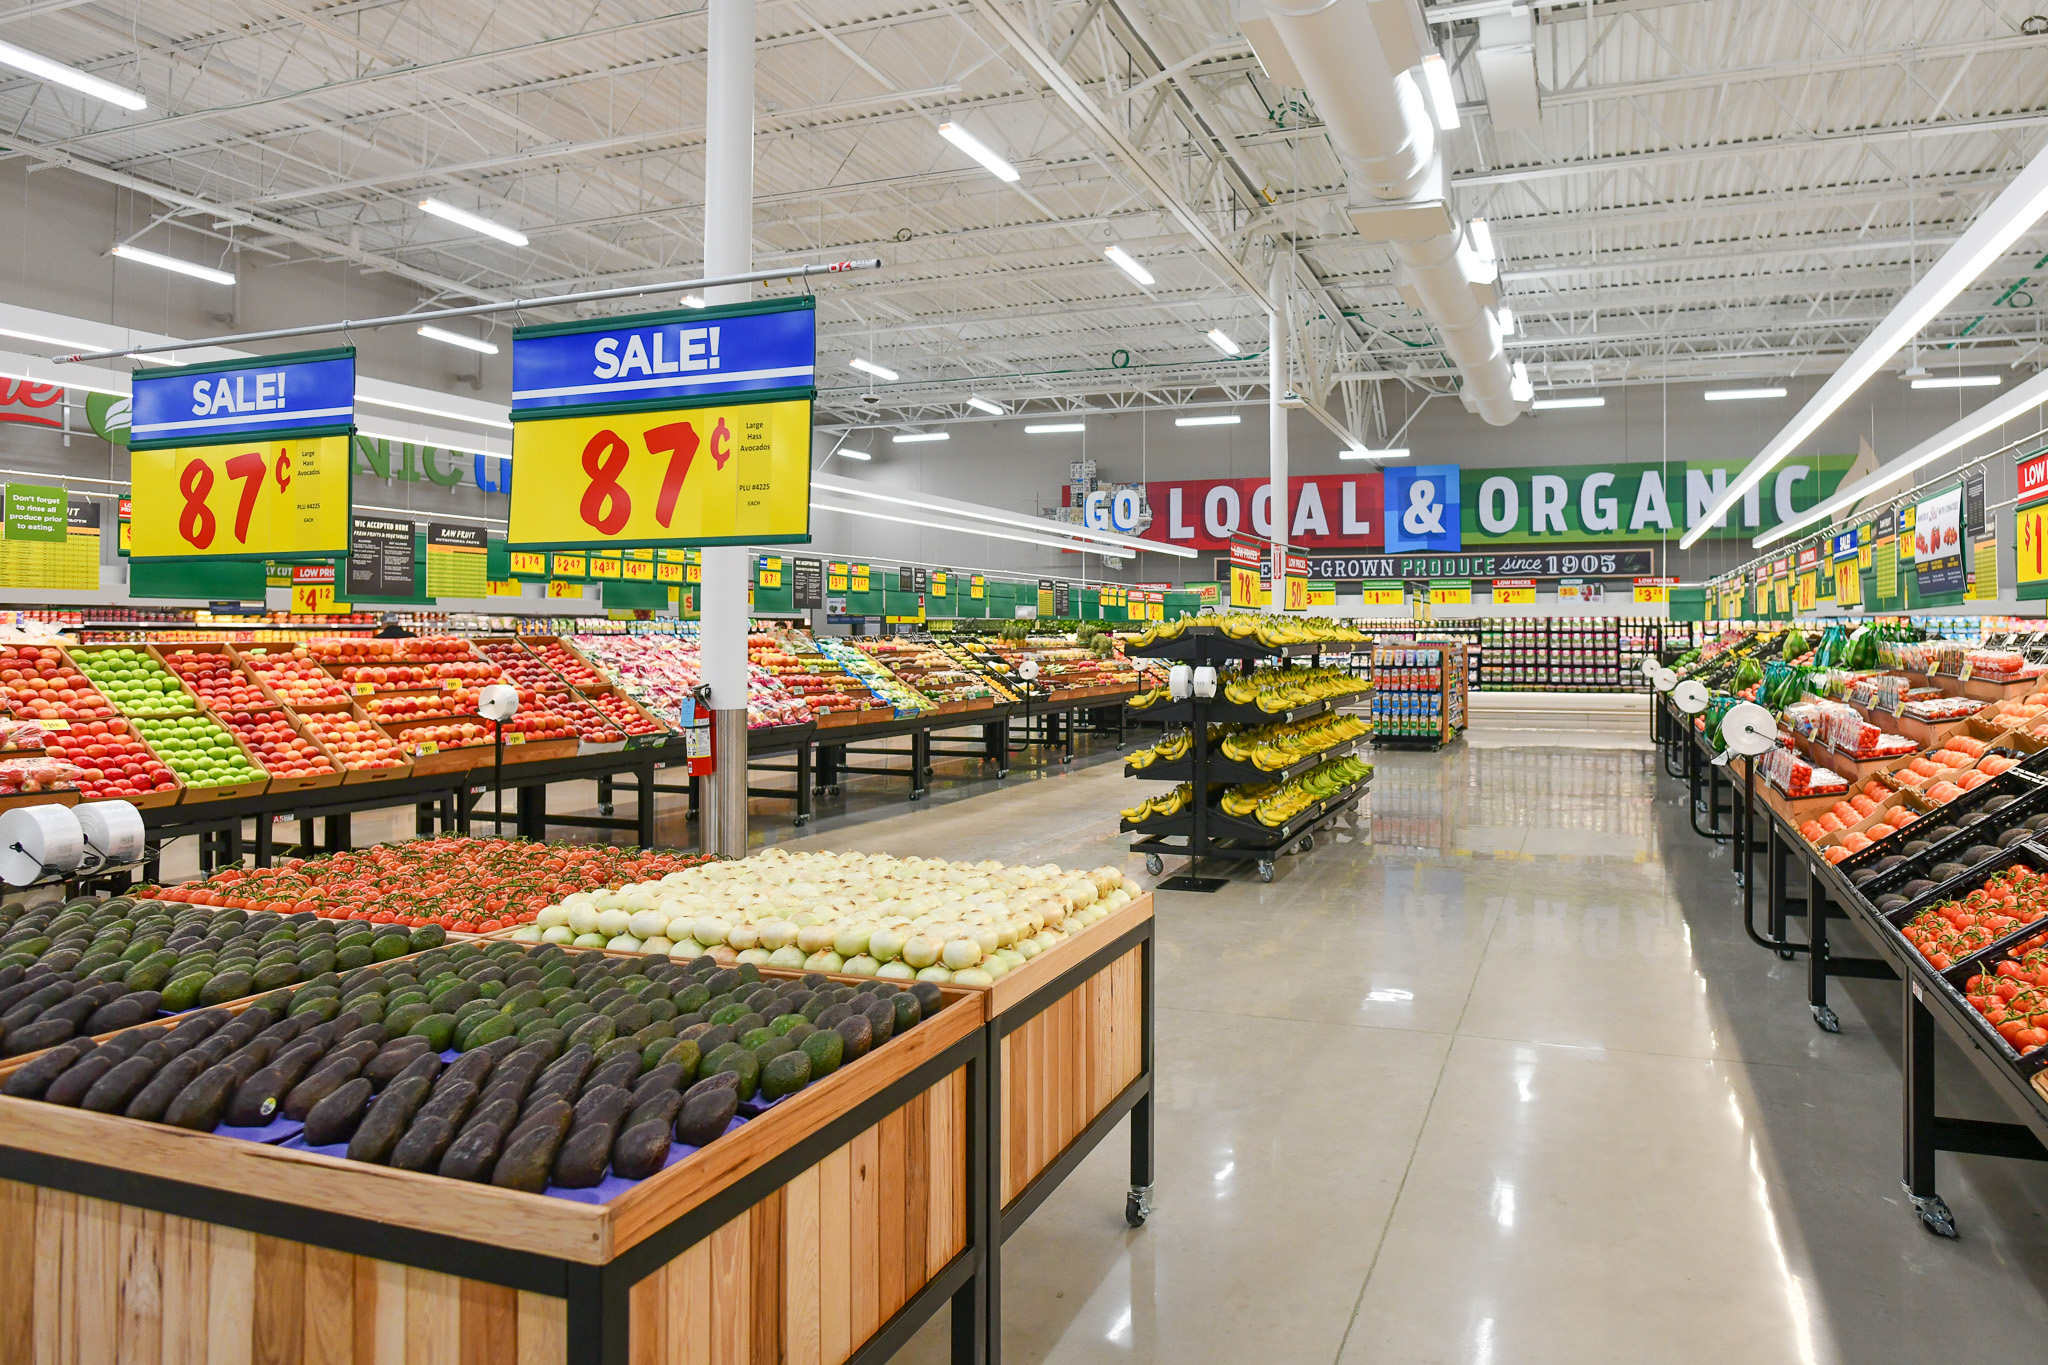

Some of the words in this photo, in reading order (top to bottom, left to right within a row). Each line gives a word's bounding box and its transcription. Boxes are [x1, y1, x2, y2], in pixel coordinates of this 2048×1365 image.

[593, 327, 720, 380] SALE!
[192, 372, 286, 416] SALE!
[746, 422, 763, 430] Large
[740, 443, 771, 452] Avocados
[13, 494, 35, 502] Don't
[36, 496, 60, 504] forget
[1085, 489, 1140, 531] GO
[1403, 479, 1446, 535] &
[1479, 464, 1811, 534] ORGANIC
[9, 513, 43, 521] produce
[44, 515, 63, 524] prior
[27, 523, 55, 531] eating.
[366, 521, 394, 531] ACCEPTED
[441, 529, 456, 538] RAW
[456, 529, 476, 539] FRUIT
[1401, 557, 1496, 576] PRODUCE
[1499, 555, 1542, 571] since
[1546, 554, 1616, 574] 1905
[277, 567, 293, 576] CUT
[300, 568, 319, 577] LOW
